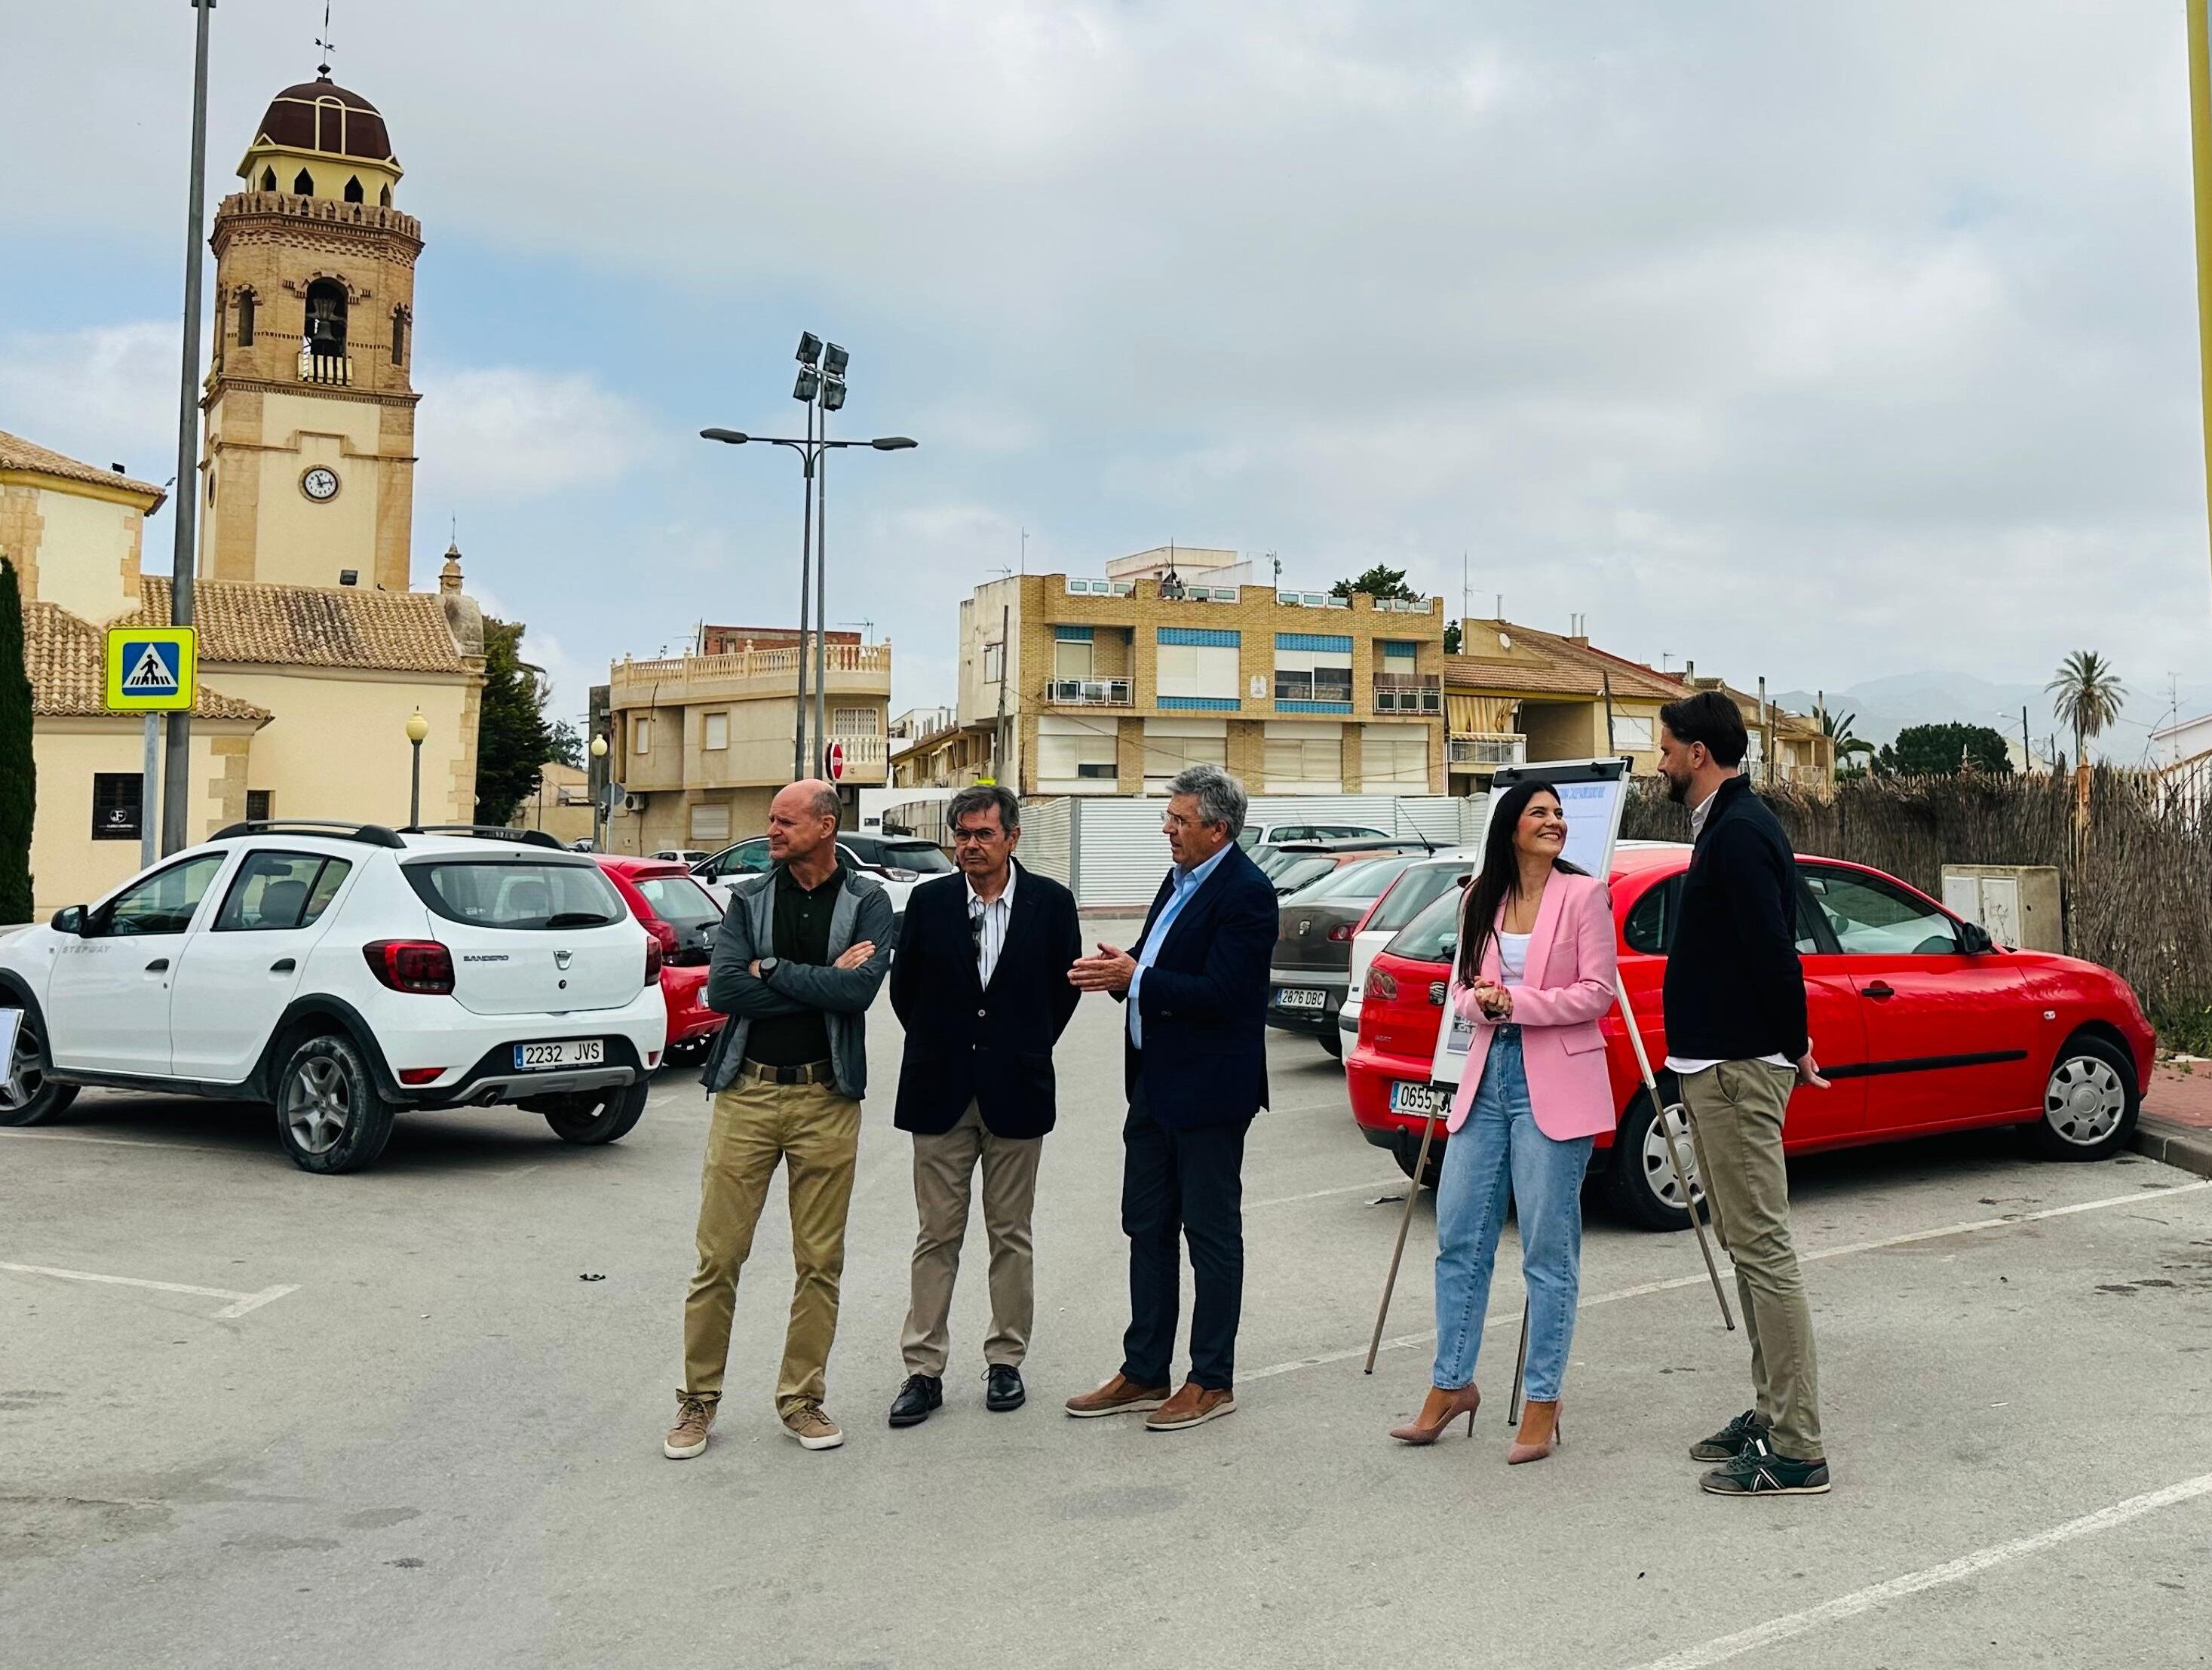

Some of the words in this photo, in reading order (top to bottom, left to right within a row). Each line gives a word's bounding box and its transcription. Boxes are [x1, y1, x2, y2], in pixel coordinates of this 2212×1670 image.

[1282, 989, 1305, 1005] 2876
[1305, 991, 1324, 1006] DBC
[526, 1045, 563, 1064] 2232
[574, 1042, 600, 1061] JVS
[1401, 1085, 1432, 1110] 0655
